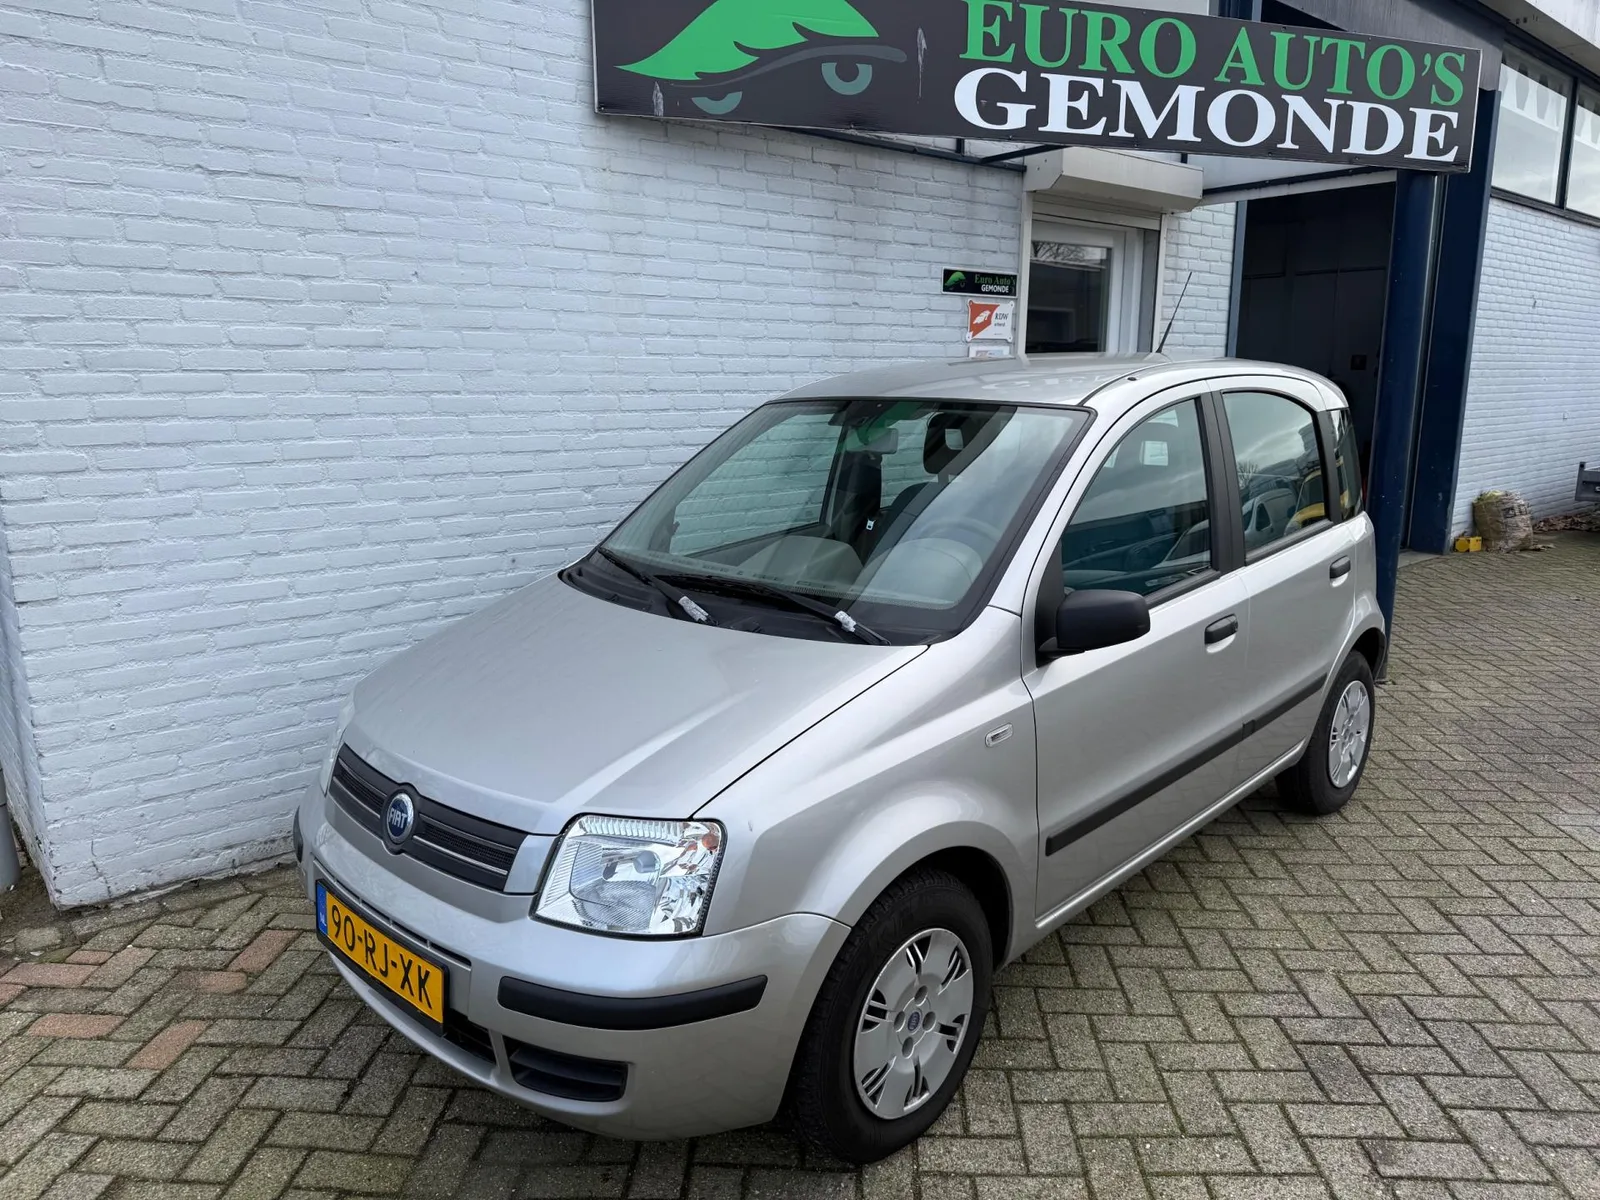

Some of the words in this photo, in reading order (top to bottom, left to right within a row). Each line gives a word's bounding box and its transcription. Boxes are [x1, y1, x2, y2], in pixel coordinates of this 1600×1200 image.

[959, 0, 1196, 78] EURO
[1214, 27, 1464, 105] AUTO'S
[954, 67, 1458, 162] GEMONDE
[974, 274, 992, 284] Euro
[981, 284, 1009, 293] GEMONDE
[388, 807, 408, 829] FIAT
[332, 904, 432, 1010] 90-RJ-XK
